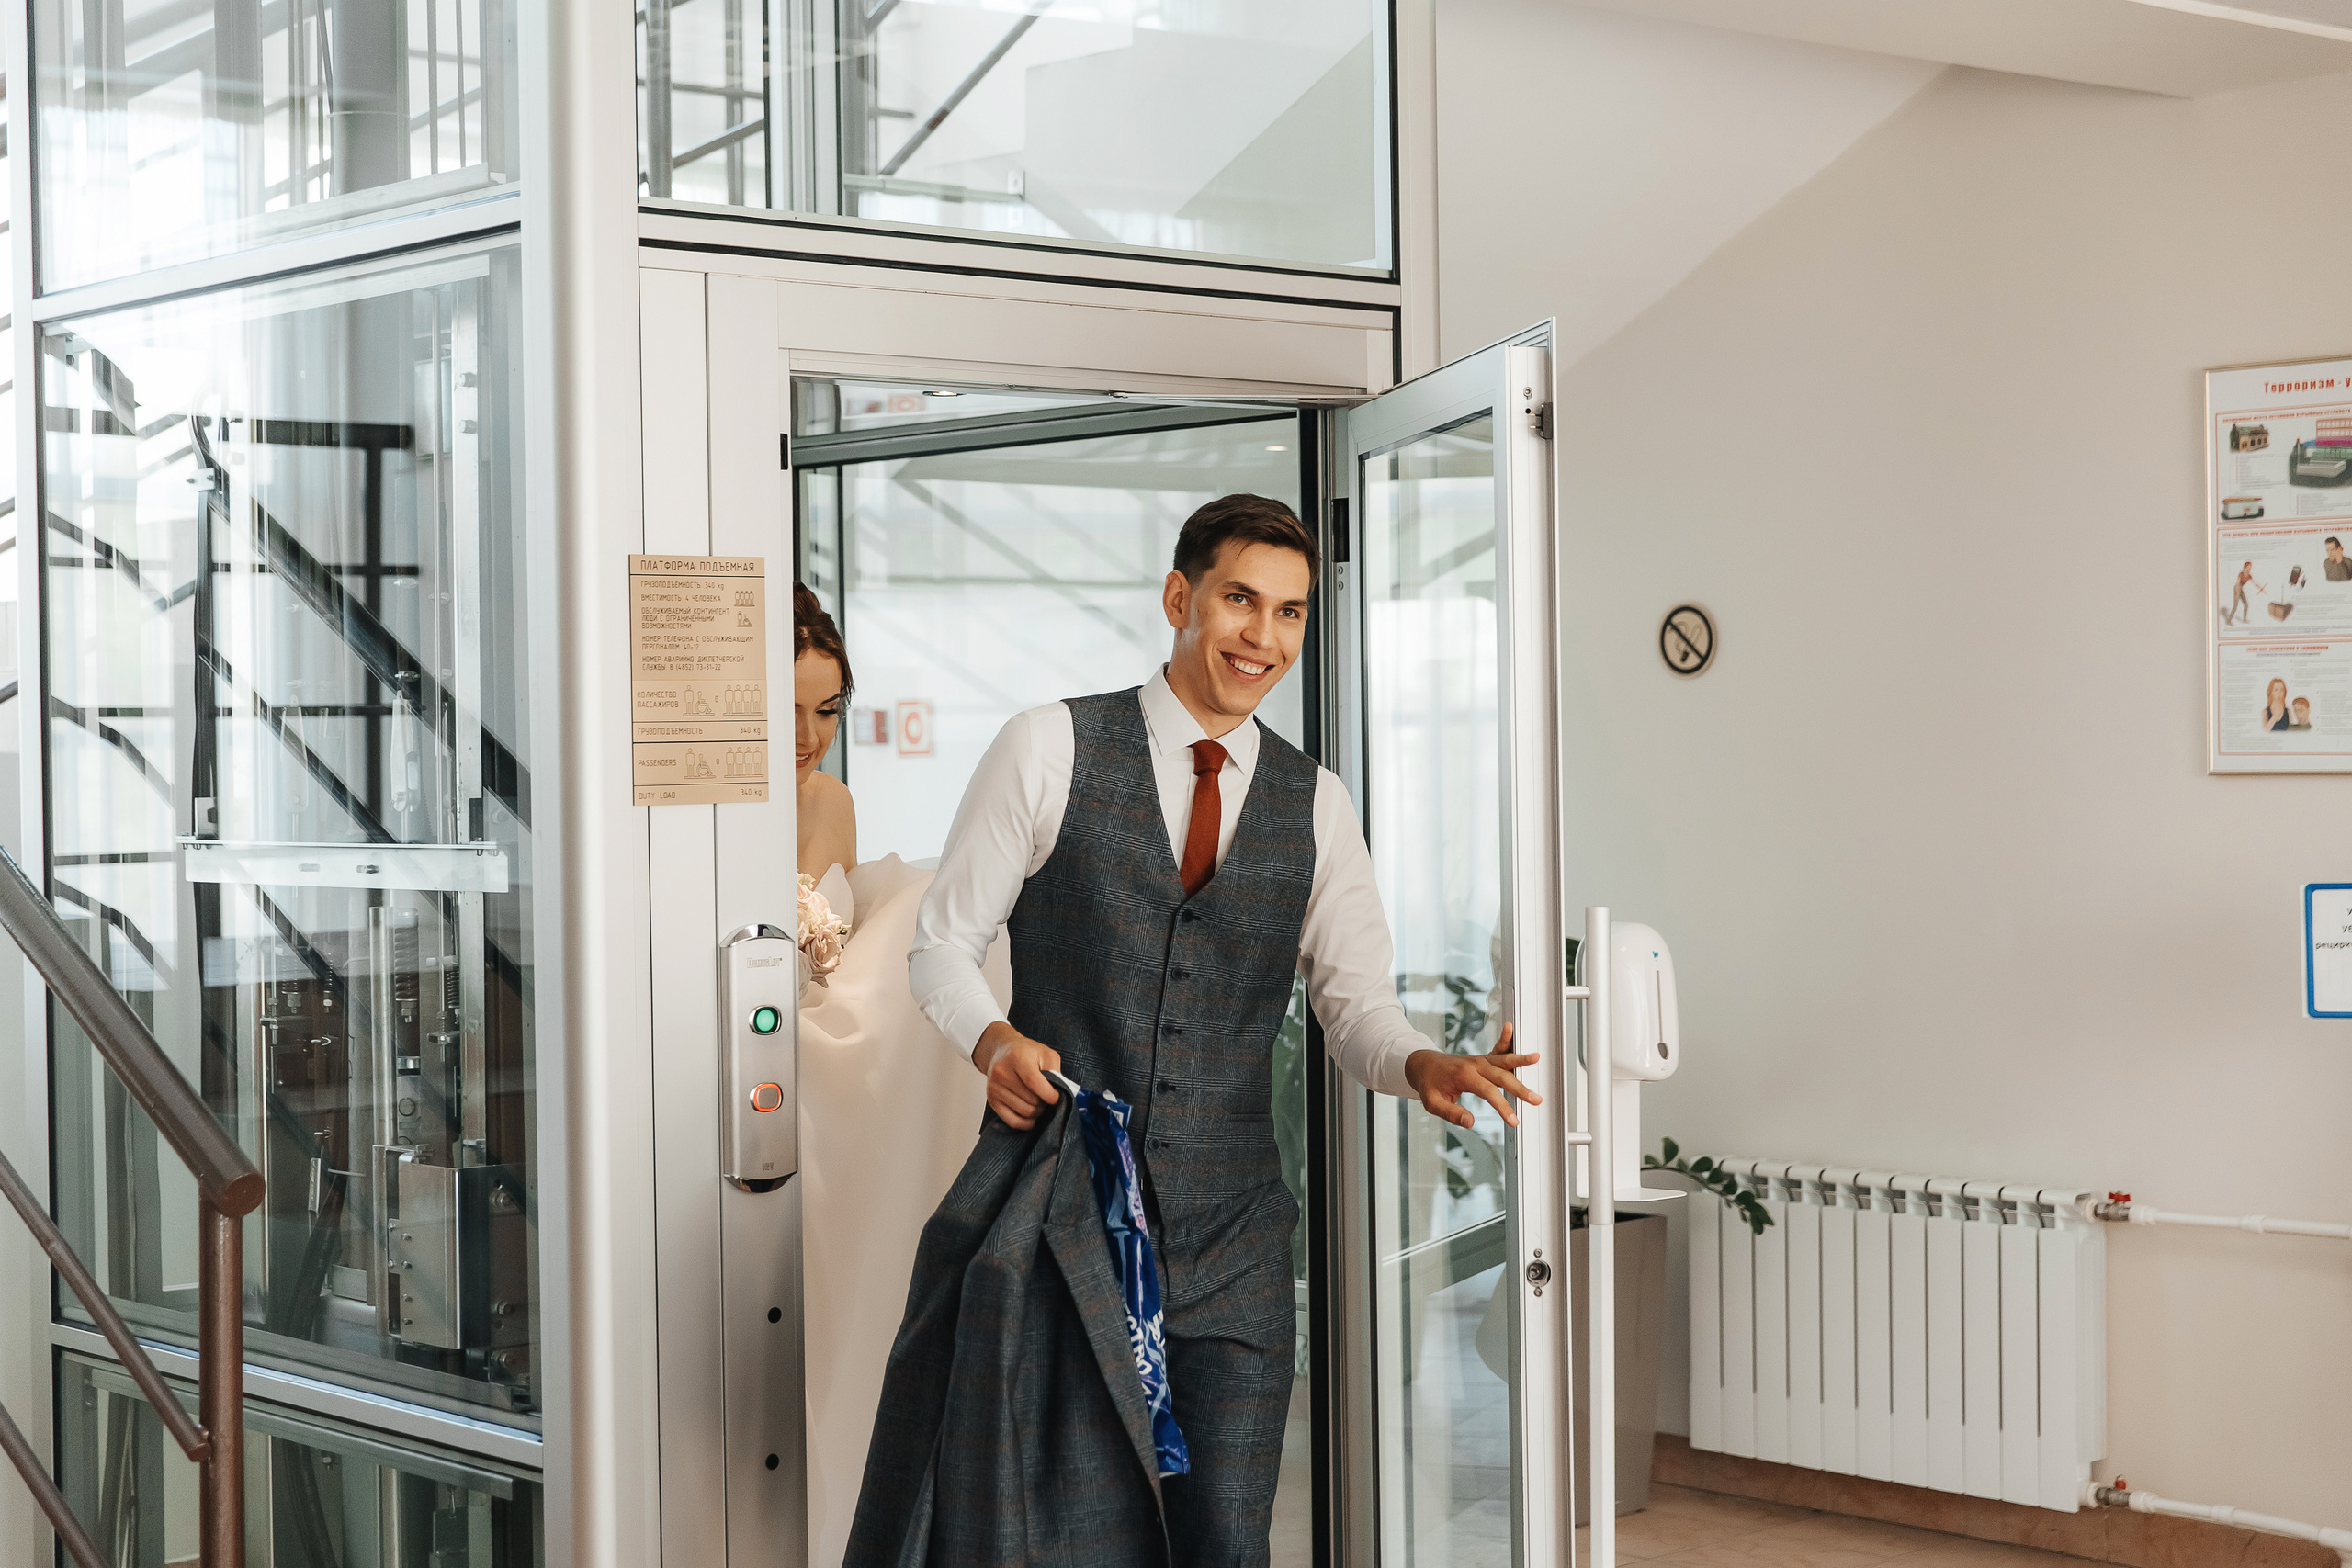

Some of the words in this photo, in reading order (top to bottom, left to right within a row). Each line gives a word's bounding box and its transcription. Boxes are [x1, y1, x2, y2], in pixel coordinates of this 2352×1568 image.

[2264, 378, 2335, 393] Терроризм
[640, 559, 695, 570] ПЛАТФОРМА
[699, 561, 755, 572] ПОДЪЕМНАЯ
[640, 581, 701, 589] ГРУЗОПОДЪЕМНОСТЬ
[717, 582, 725, 591] kg
[640, 593, 682, 602] ВМЕСТИМОСТЬ
[692, 594, 721, 603] ЧЕЛОВЕКА
[641, 606, 692, 615] ОБСЛУЖИВАЕМЫЙ
[666, 615, 715, 623] ОГРАНИЧЕННЫМИ
[663, 635, 694, 643] ТЕЛЕФОНА
[695, 635, 700, 643] С
[702, 635, 753, 643] ОБСЛУЖИВАЮЩИМ
[637, 691, 677, 699] КОЛИЧЕСТВО
[637, 700, 679, 708] ПАССАЖИРОВ
[637, 727, 704, 735] ГРУЗОПОДЪЕМНОСТЬ
[740, 726, 752, 734] 340
[753, 727, 762, 736] kg
[638, 759, 677, 767] PASSENGERS
[639, 792, 656, 800] DUTY
[660, 791, 676, 799] LOAD
[741, 788, 752, 796] 340
[754, 788, 763, 797] kg
